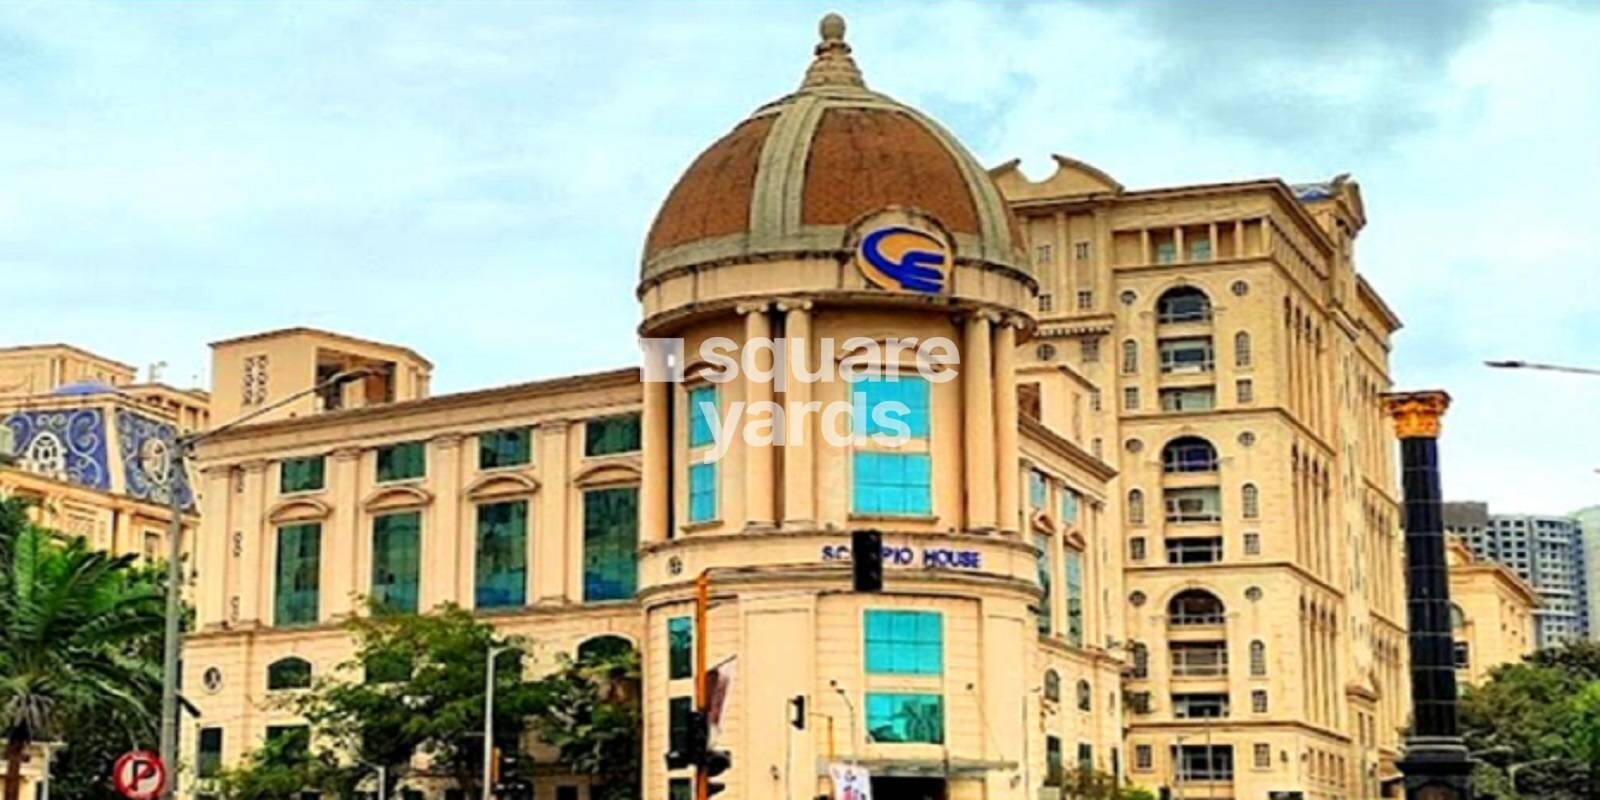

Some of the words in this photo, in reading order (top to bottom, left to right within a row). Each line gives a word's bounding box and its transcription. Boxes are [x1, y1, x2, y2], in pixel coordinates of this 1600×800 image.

[822, 545, 914, 565] SCPIO
[923, 549, 981, 568] HOUSE
[132, 760, 157, 791] P
